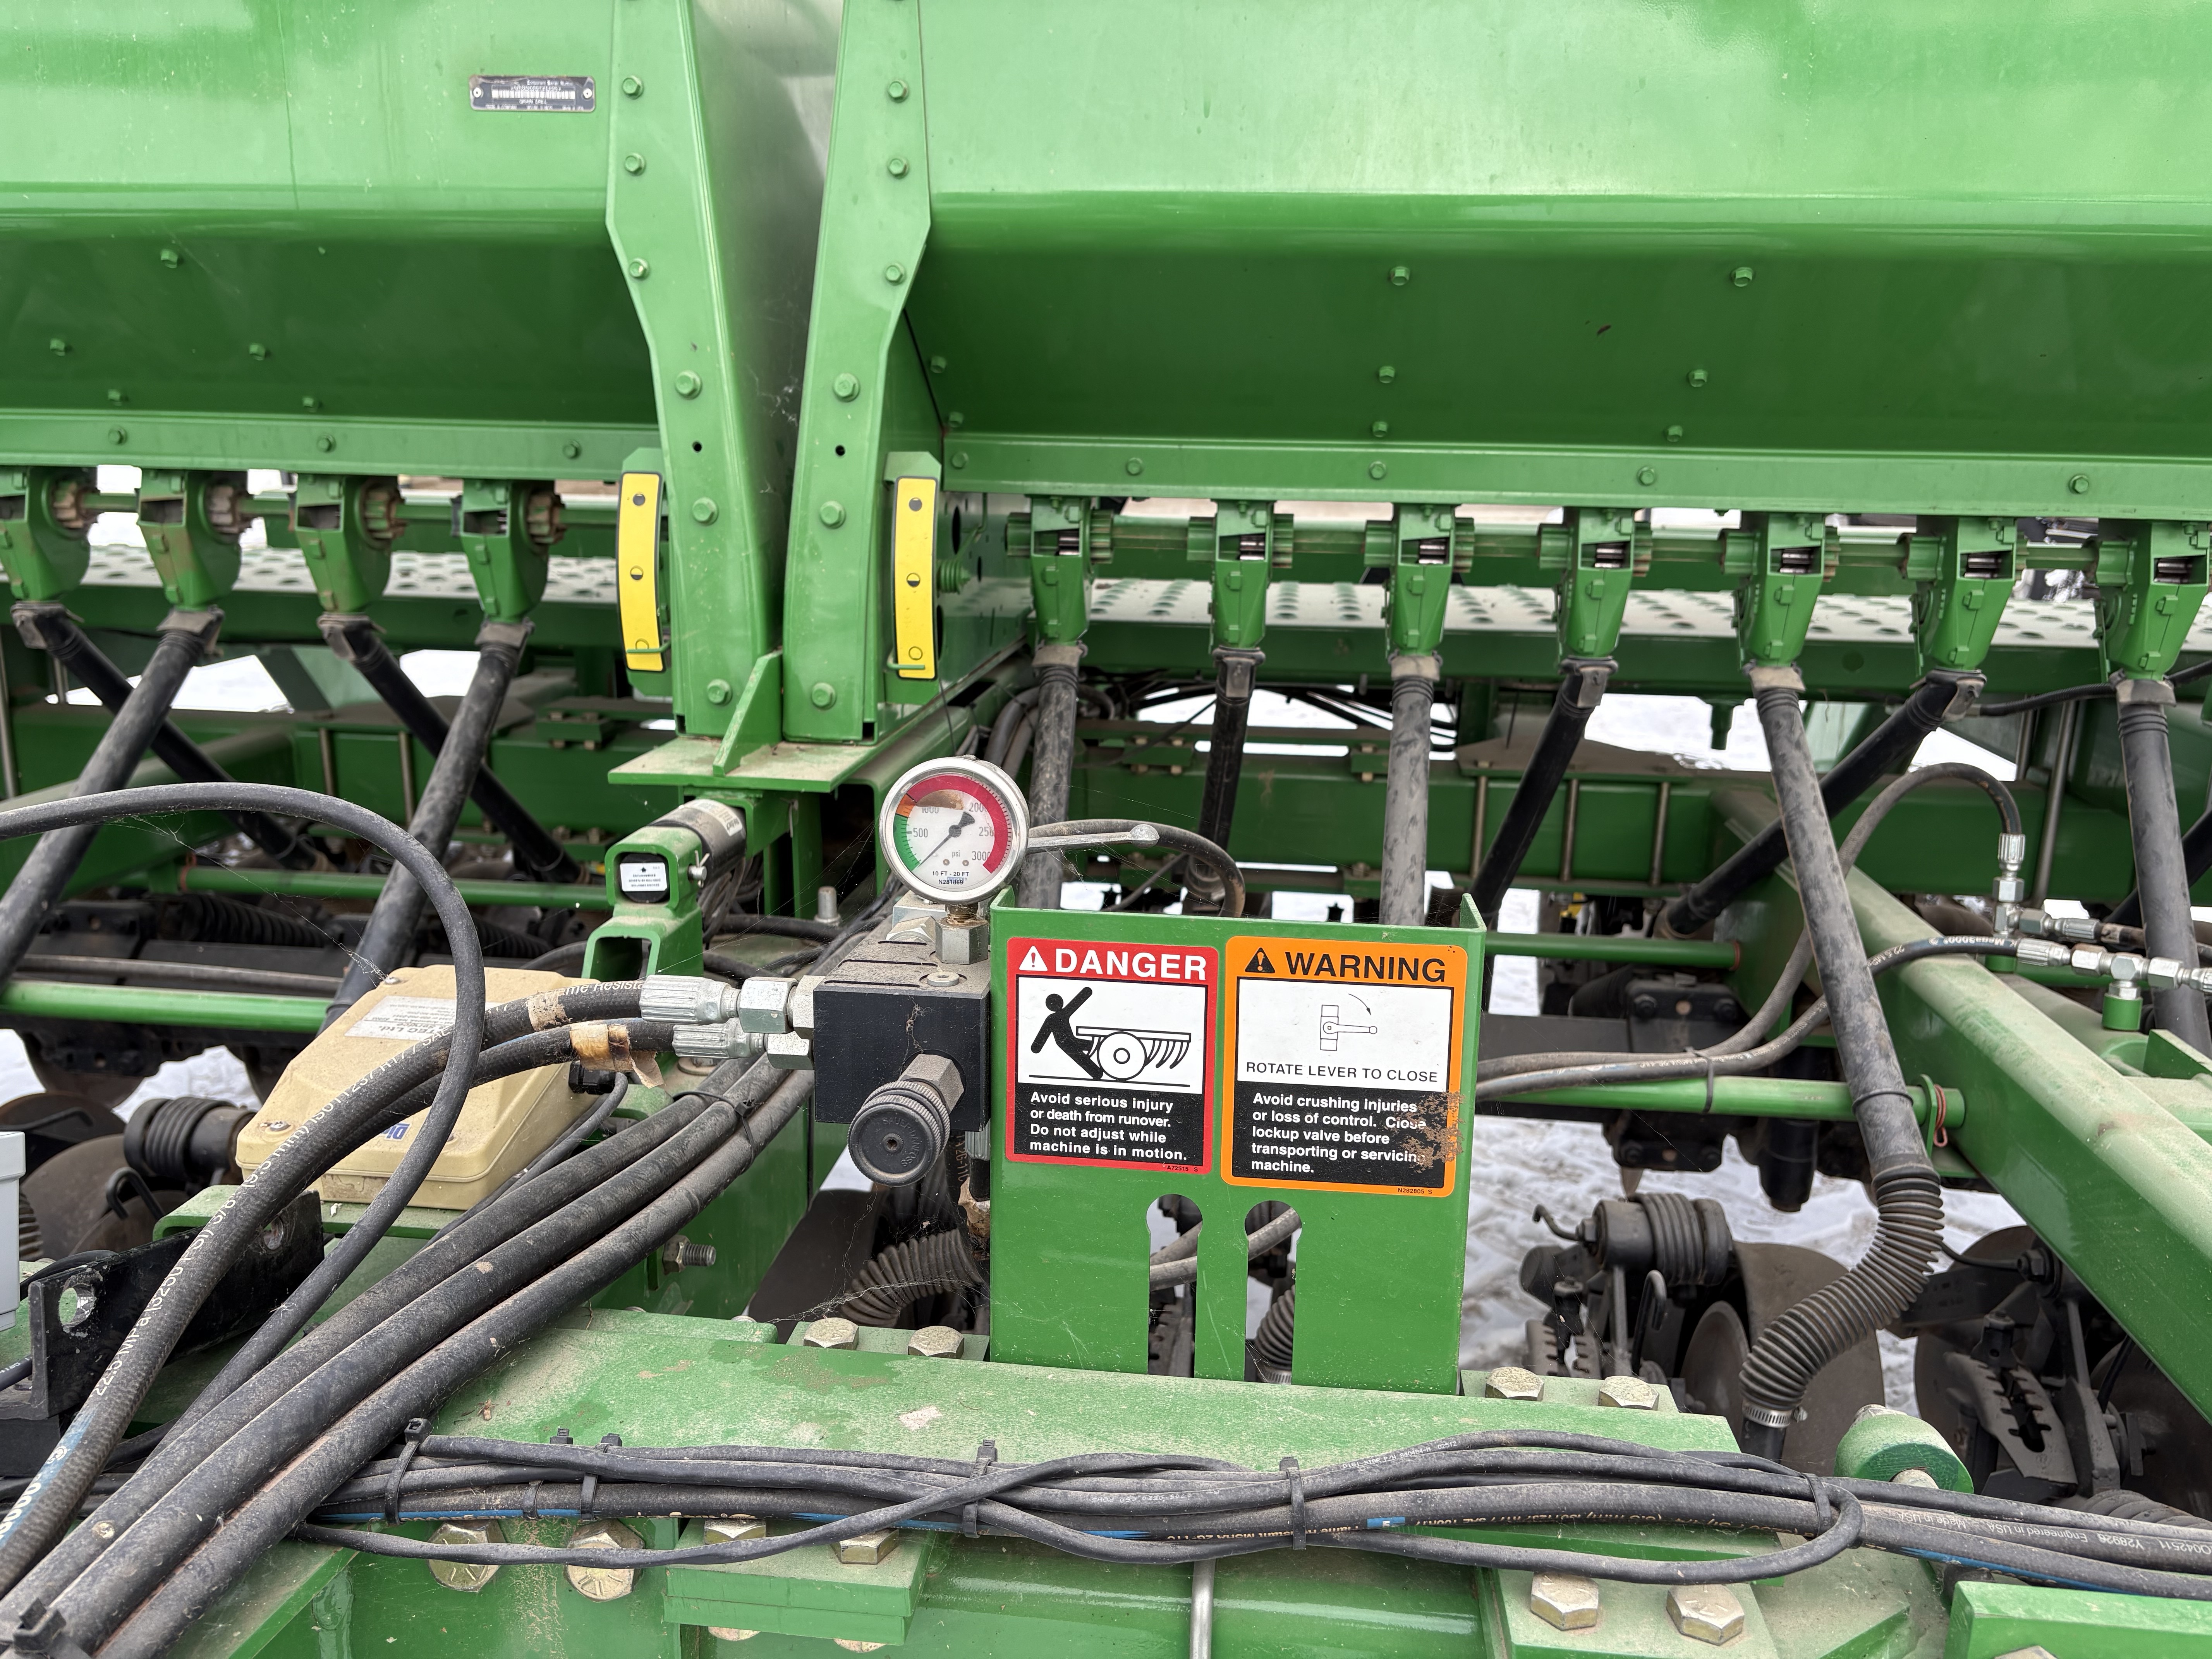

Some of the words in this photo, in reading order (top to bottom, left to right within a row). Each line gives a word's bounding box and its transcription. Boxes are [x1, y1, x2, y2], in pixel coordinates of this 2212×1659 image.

[913, 828, 928, 838] 500
[1055, 948, 1206, 981] DANGER
[1285, 951, 1446, 982] WARNING
[1246, 1062, 1303, 1075] ROTATE
[1309, 1065, 1357, 1078] LEVER
[1362, 1068, 1382, 1080] TO
[1387, 1070, 1438, 1083] CLOSE
[1030, 1092, 1070, 1105] Avoid
[1075, 1096, 1128, 1108] serious
[1132, 1098, 1173, 1114] injury
[1253, 1093, 1293, 1106] Avoid
[1297, 1097, 1360, 1113] crushing
[1364, 1098, 1417, 1113] injuries
[1030, 1110, 1044, 1119] or
[1046, 1109, 1082, 1121] death
[1085, 1110, 1115, 1123] from
[1118, 1116, 1171, 1128] runover.
[1252, 1113, 1267, 1121] or
[1271, 1111, 1300, 1124] loss
[1304, 1114, 1318, 1124] of
[1322, 1115, 1377, 1128] control.
[1385, 1117, 1427, 1130] Close
[1030, 1123, 1049, 1135] Do
[1053, 1126, 1076, 1137] not
[1080, 1127, 1125, 1142] adjust
[1128, 1130, 1166, 1143] while
[1252, 1126, 1299, 1142] lockup
[1303, 1129, 1340, 1143] valve
[1345, 1130, 1390, 1145] before
[1030, 1140, 1091, 1154] machine
[1096, 1144, 1108, 1154] is
[1114, 1144, 1126, 1156] in
[1132, 1147, 1187, 1161] motion.
[1251, 1142, 1338, 1160] transporting
[1342, 1150, 1358, 1159] or
[1251, 1160, 1314, 1174] machine.
[92, 1358, 122, 1396] 22.5
[117, 1316, 151, 1355] MPa
[272, 1124, 310, 1158] mm)
[421, 1026, 453, 1047] SAE
[1898, 1512, 1924, 1524] USA
[1925, 1515, 1936, 1525] in
[1937, 1516, 1966, 1529] Made
[1987, 1522, 2013, 1535] USA
[2014, 1525, 2025, 1535] in
[2026, 1527, 2088, 1543] Engineered
